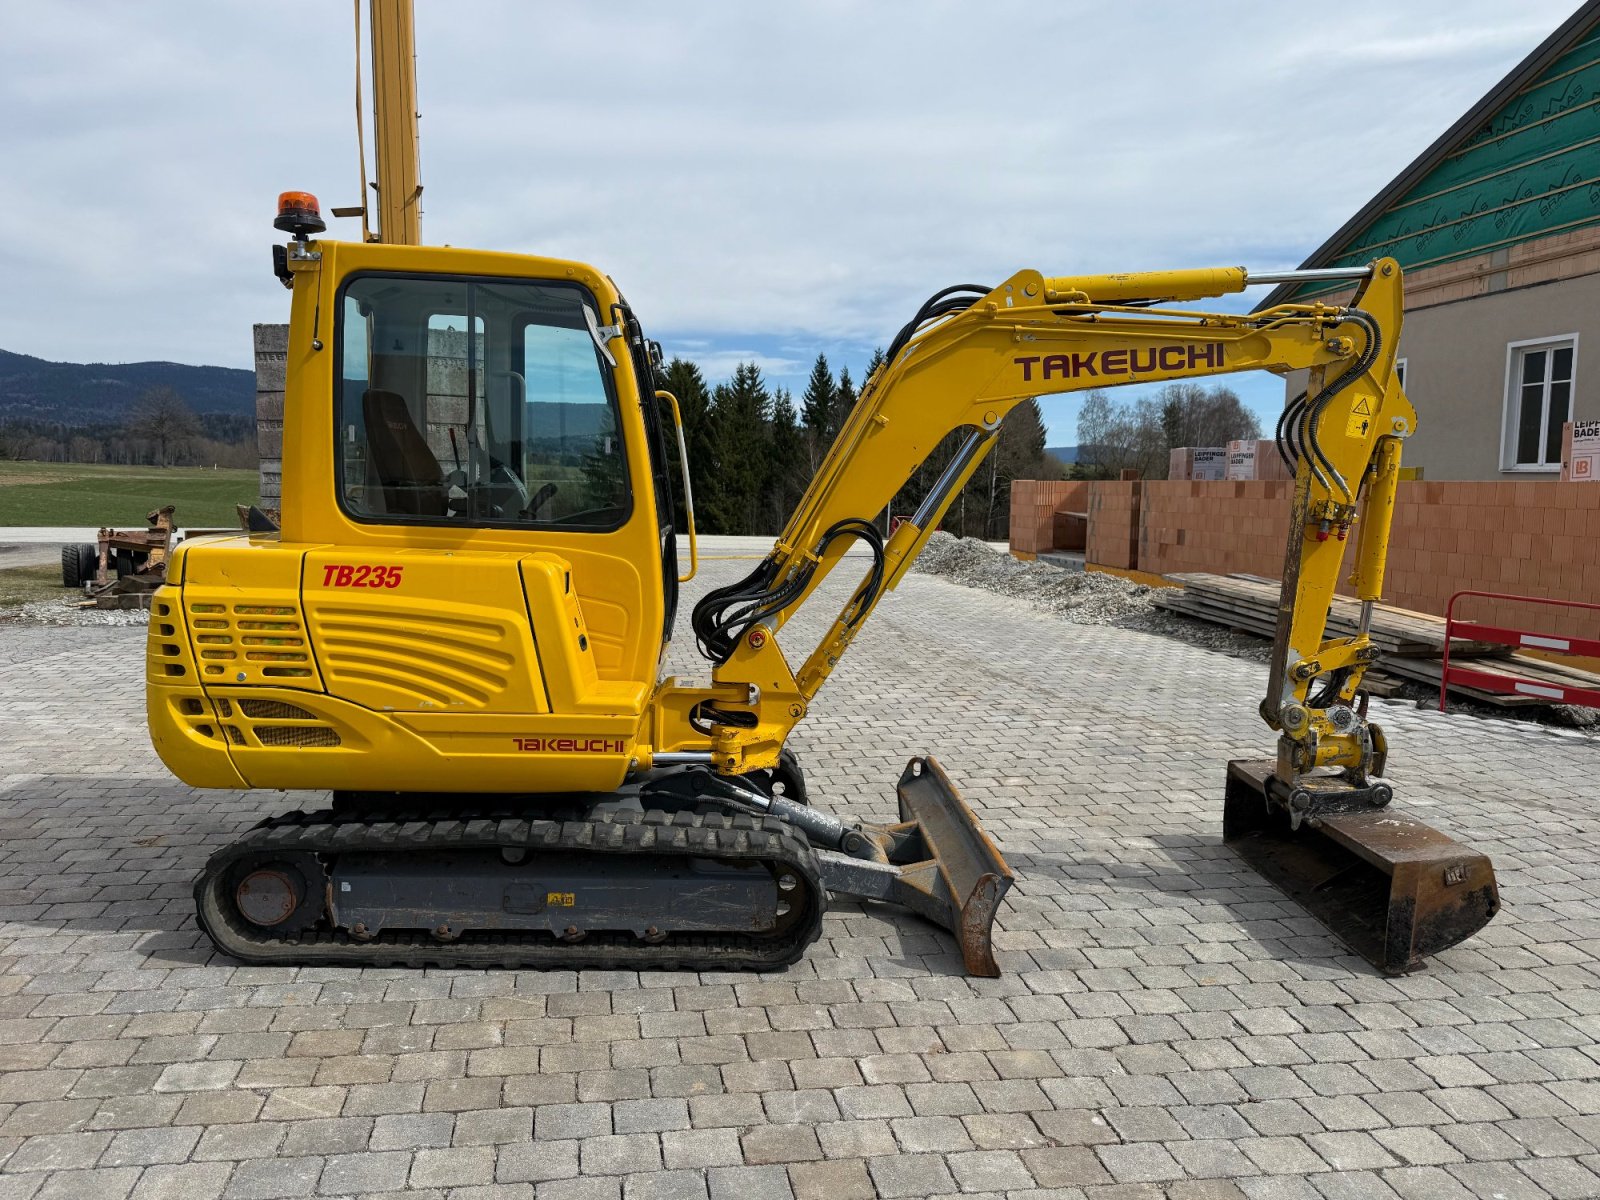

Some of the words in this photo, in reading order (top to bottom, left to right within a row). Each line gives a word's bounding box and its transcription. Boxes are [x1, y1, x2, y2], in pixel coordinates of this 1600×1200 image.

[1014, 343, 1224, 381] TAKEUCHI
[322, 565, 403, 588] TB235
[513, 738, 624, 752] TAKEUCHI
